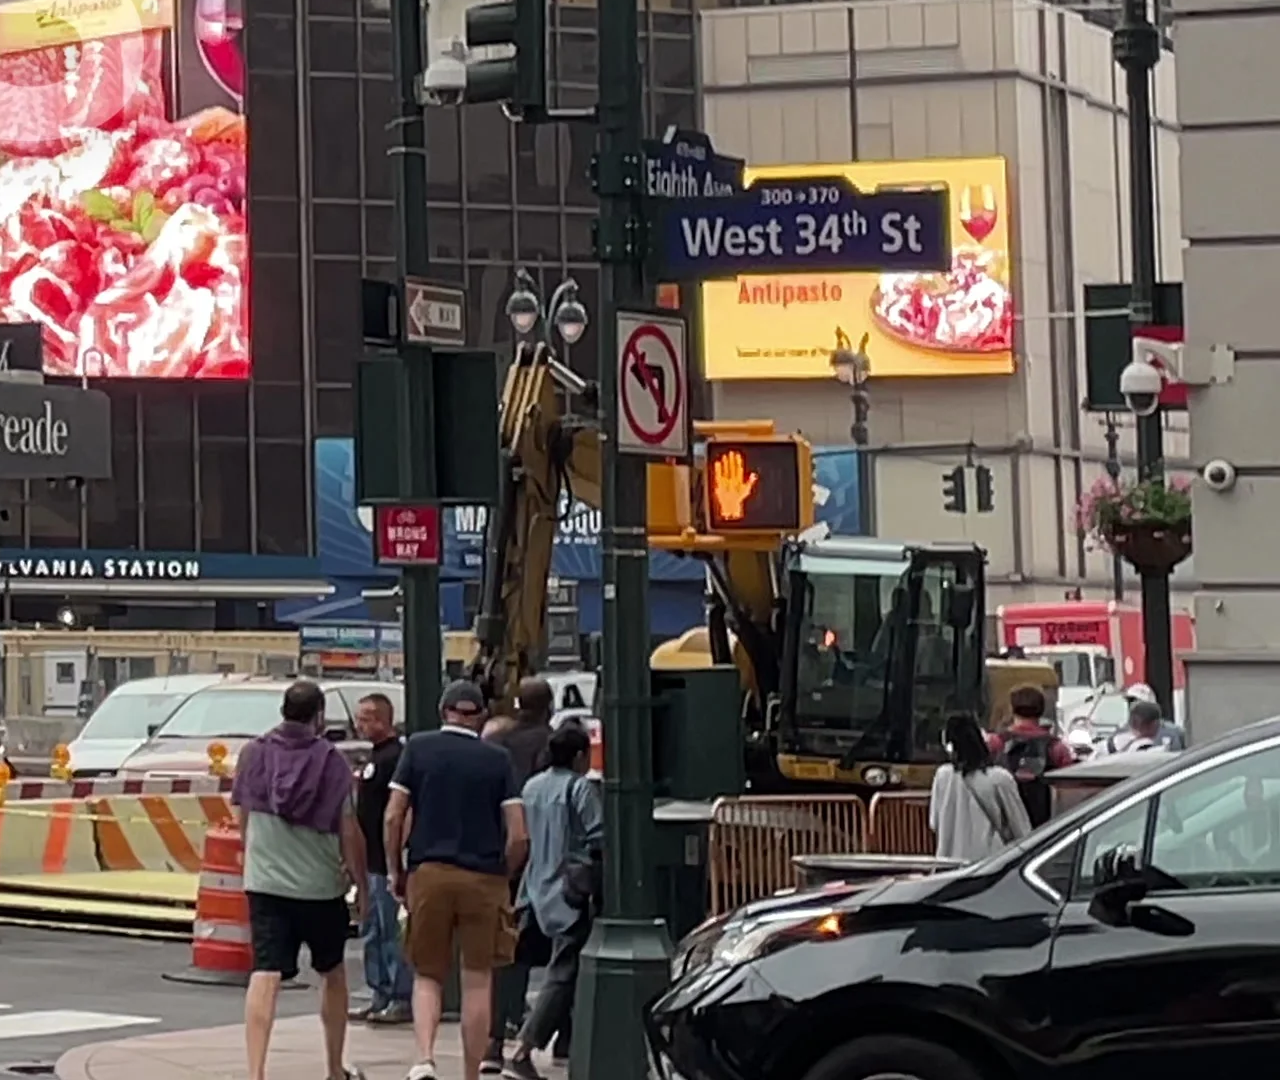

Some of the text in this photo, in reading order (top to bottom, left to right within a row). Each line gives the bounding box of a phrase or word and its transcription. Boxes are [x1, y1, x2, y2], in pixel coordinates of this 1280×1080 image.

[682, 209, 922, 257] West 34th St
[738, 279, 843, 309] Antipasto
[387, 526, 428, 541] WRONG
[396, 543, 420, 557] WAY
[104, 558, 200, 578] STATION
